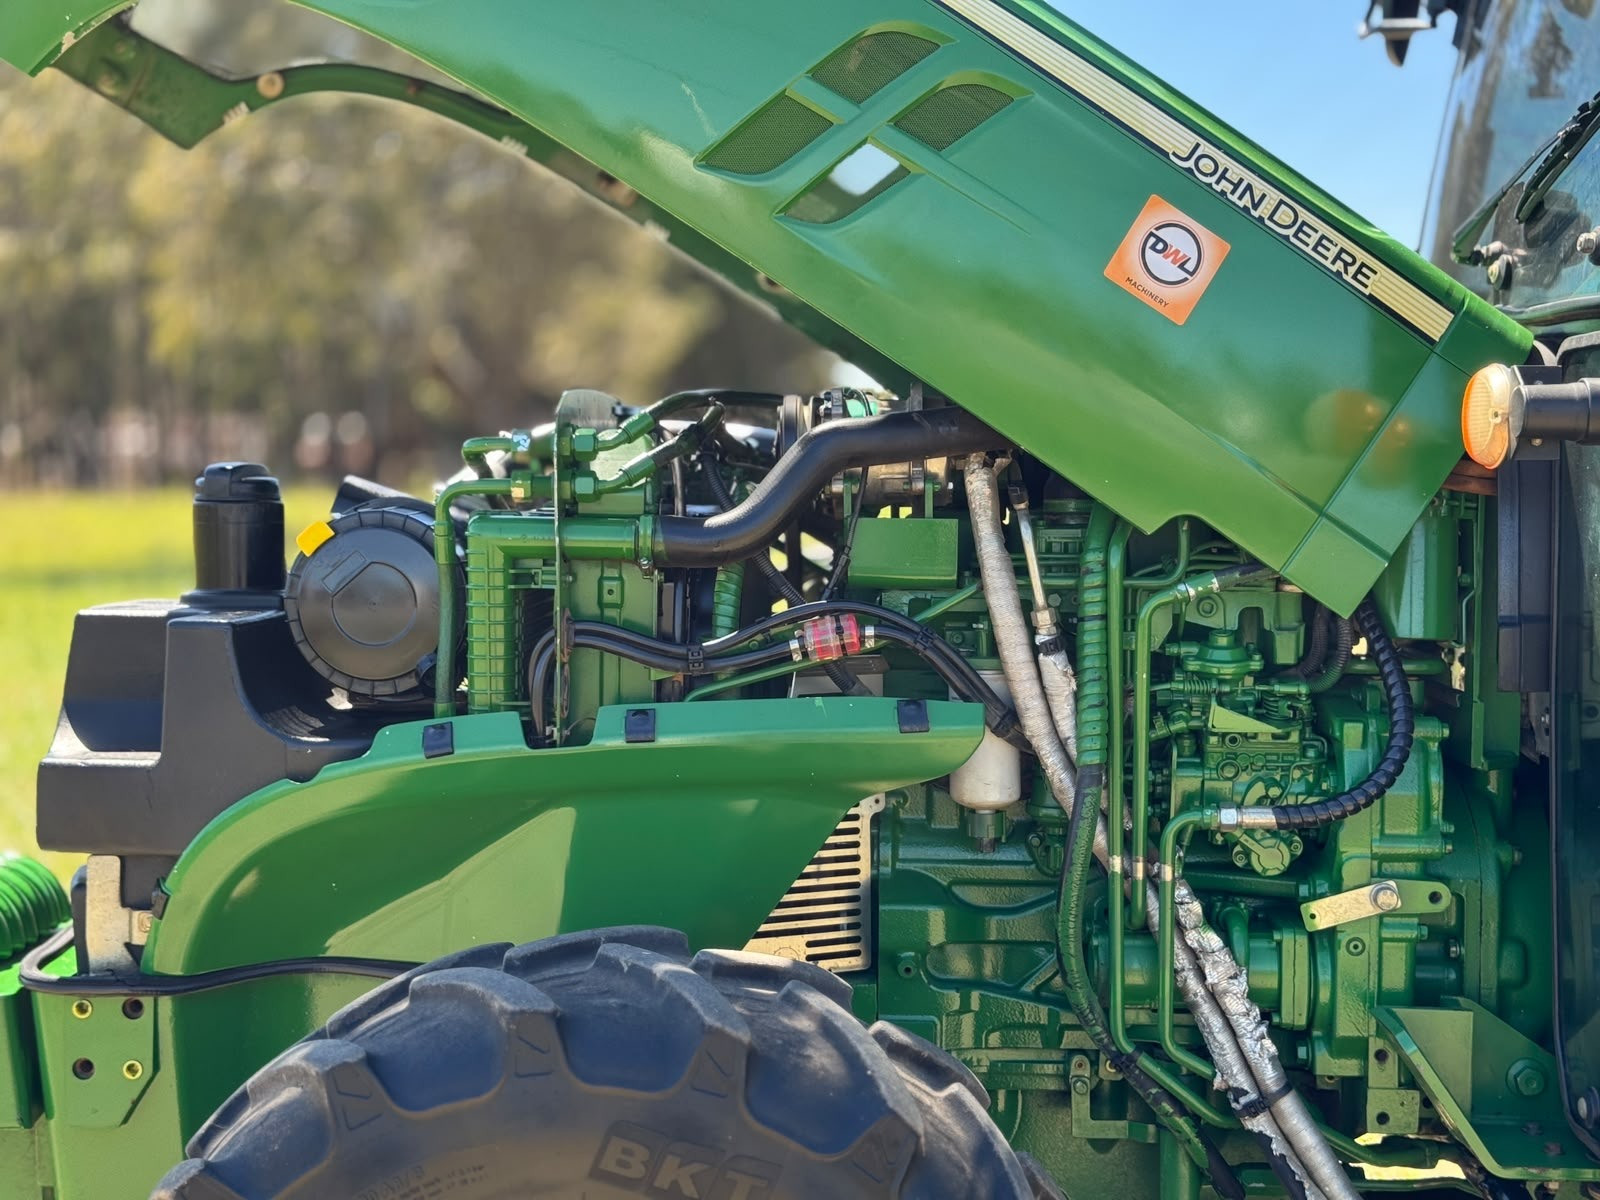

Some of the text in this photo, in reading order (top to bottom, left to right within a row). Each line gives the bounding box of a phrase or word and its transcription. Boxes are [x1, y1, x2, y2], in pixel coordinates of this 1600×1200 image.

[1170, 142, 1378, 291] JOHN DEERE
[1145, 231, 1194, 278] DWL
[1124, 276, 1170, 308] MACHINERY
[598, 1135, 769, 1200] BKT
